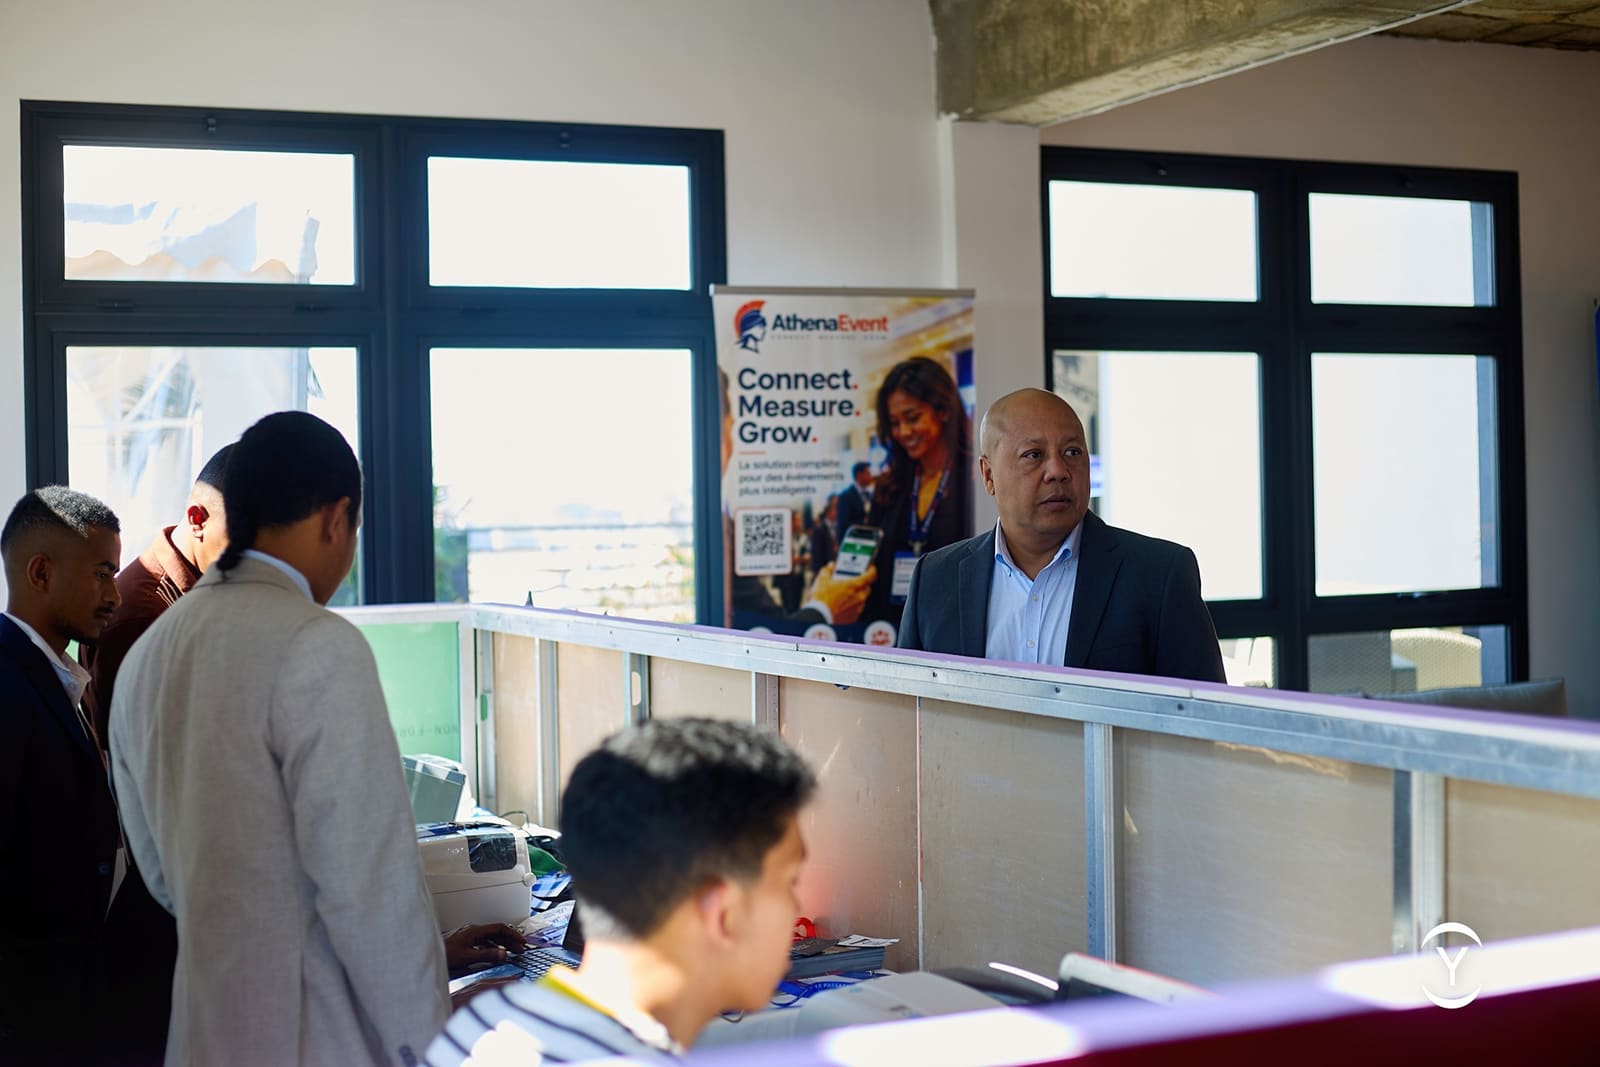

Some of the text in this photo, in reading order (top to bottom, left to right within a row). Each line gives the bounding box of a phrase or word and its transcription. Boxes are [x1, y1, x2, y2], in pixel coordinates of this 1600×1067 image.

[771, 313, 889, 332] AthenaEvent
[738, 367, 859, 390] Connect.
[738, 395, 861, 417] Measure.
[738, 421, 818, 443] Grow.
[753, 461, 793, 469] solution
[739, 475, 762, 484] pour
[738, 487, 760, 496] plus
